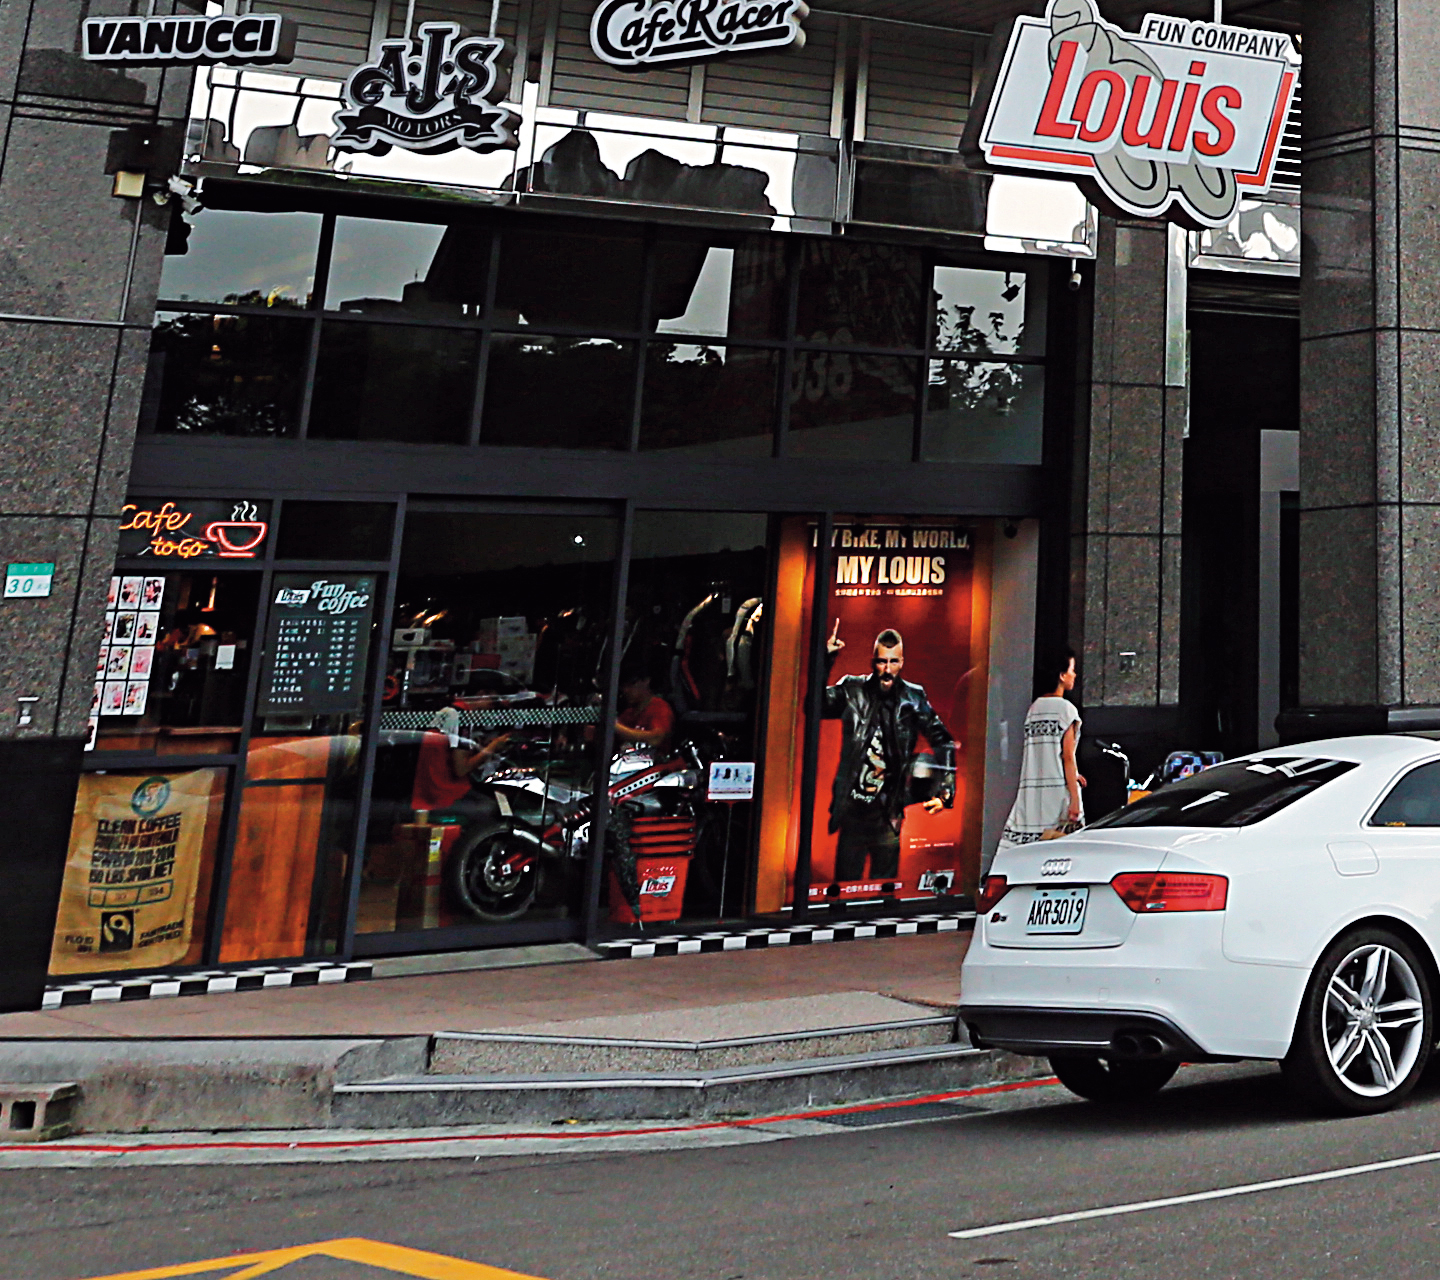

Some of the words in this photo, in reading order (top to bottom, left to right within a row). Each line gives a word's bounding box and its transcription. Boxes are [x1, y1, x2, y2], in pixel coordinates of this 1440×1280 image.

[87, 18, 276, 58] VANUCCI
[1146, 20, 1185, 43] FUN
[1191, 28, 1287, 58] COMPANY
[1035, 40, 1242, 155] Louis
[385, 112, 462, 139] MOTORS
[118, 502, 193, 532] Cafe
[836, 556, 875, 585] MY
[878, 556, 946, 585] LOUIS
[7, 578, 34, 594] 30
[310, 580, 346, 599] Fun
[318, 590, 369, 615] coffee
[138, 813, 182, 833] COFFEE
